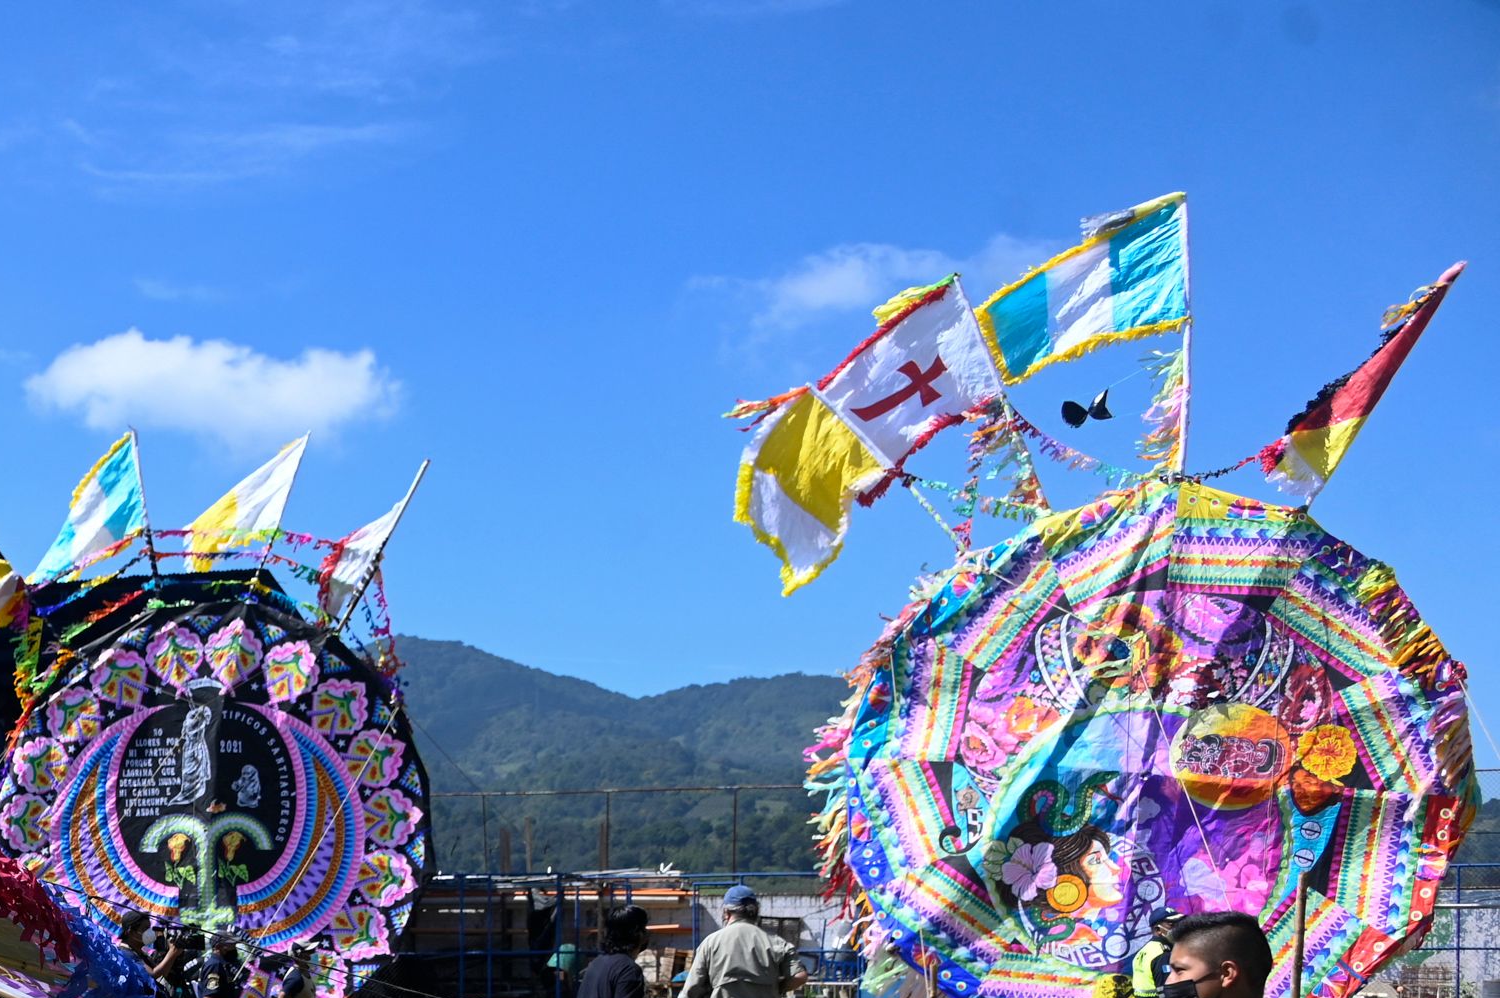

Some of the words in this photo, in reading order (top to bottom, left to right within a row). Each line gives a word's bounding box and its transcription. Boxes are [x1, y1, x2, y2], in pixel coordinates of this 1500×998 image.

[222, 710, 267, 736] TIPICOS
[135, 738, 161, 747] LLORES
[166, 737, 180, 747] POR
[219, 740, 242, 753] 2021
[129, 749, 137, 758] MI
[125, 758, 152, 768] PORQUE
[132, 787, 160, 797] CAMINO
